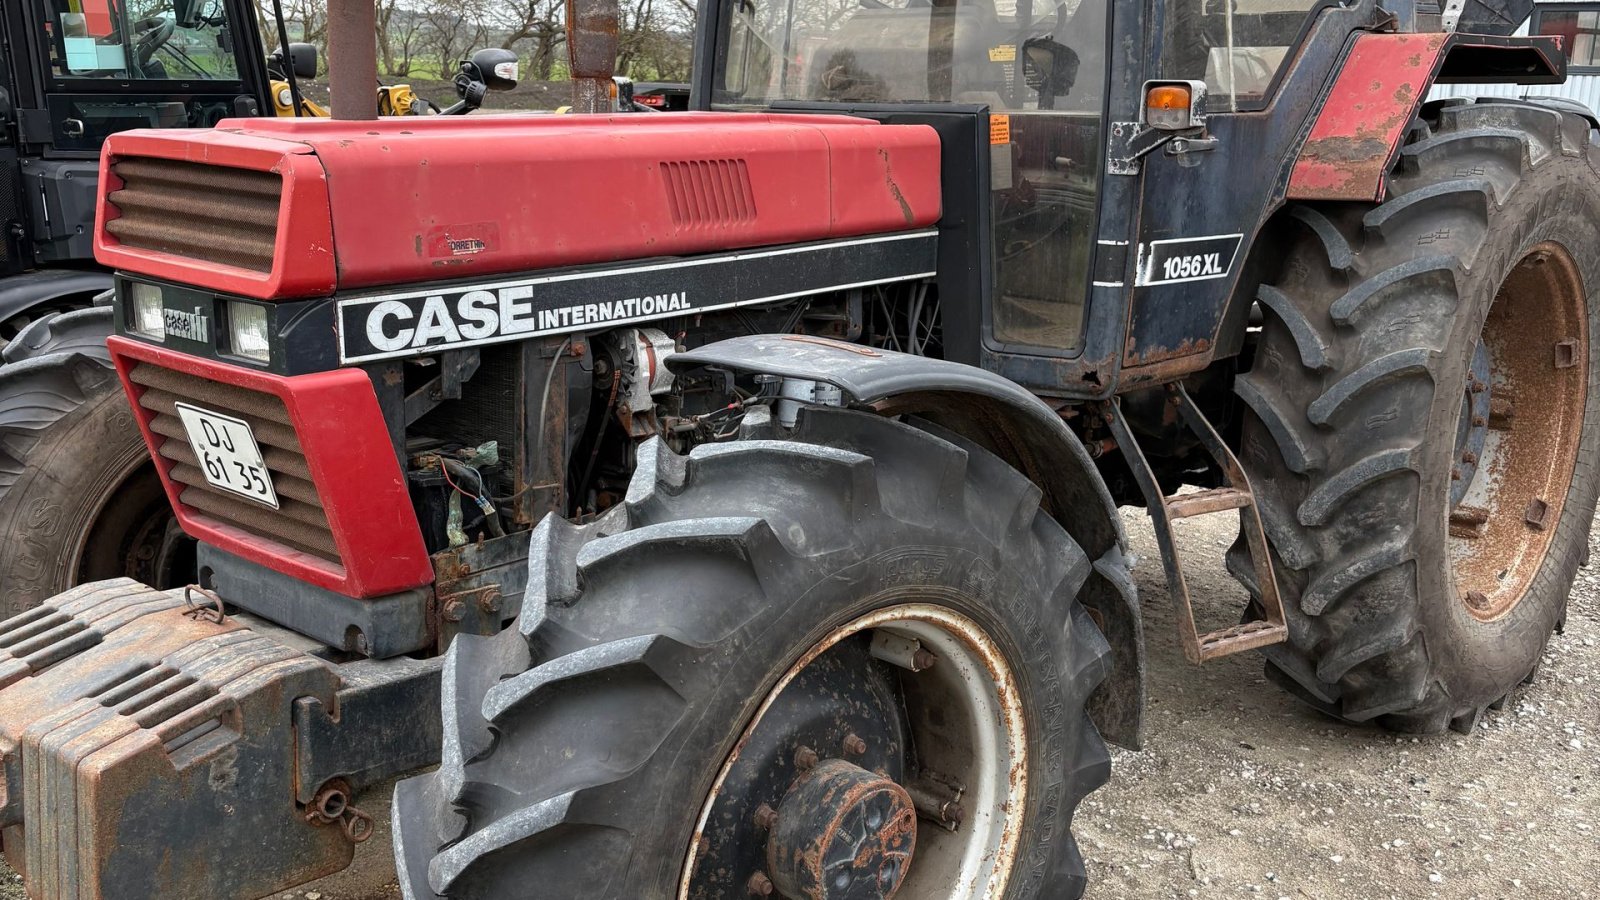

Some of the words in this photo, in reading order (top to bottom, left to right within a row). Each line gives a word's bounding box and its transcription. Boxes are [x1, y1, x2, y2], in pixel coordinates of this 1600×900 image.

[366, 286, 534, 352] CASE
[538, 292, 691, 330] INTERNATIONAL
[200, 418, 235, 453] DJ
[204, 452, 231, 484] 61
[233, 461, 267, 495] 35
